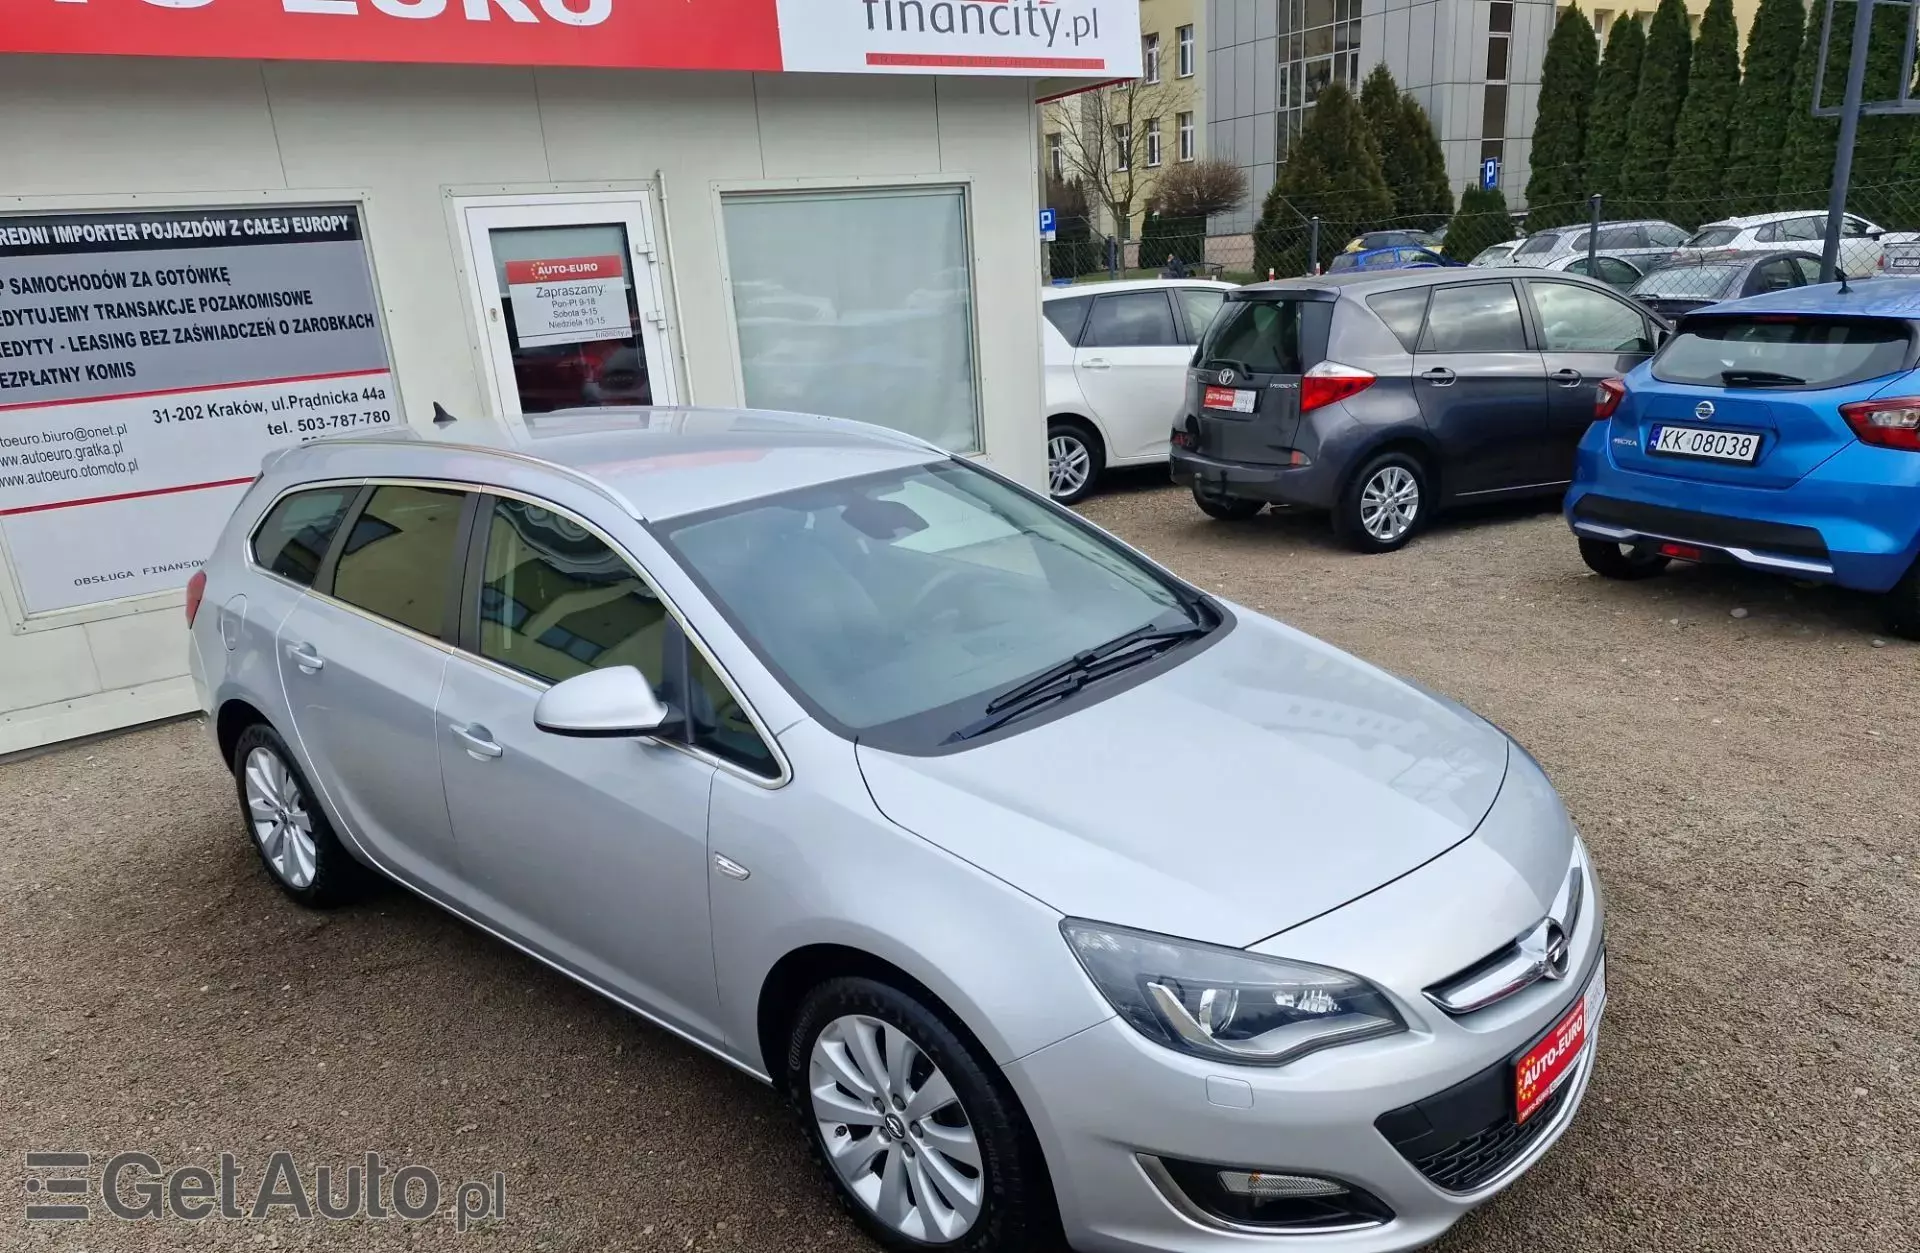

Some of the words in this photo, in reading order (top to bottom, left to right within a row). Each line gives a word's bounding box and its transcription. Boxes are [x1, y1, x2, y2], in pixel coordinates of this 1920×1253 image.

[1487, 161, 1495, 183] P
[52, 223, 139, 243] IMPORTER
[141, 216, 227, 240] POJAZDÓW
[230, 219, 241, 236] Z
[243, 216, 289, 235] CAŁEJ
[292, 214, 348, 233] EUROPY
[1041, 211, 1051, 229] P
[9, 268, 127, 295] SAMOCHODÓW
[130, 271, 152, 289] ZA
[155, 264, 231, 287] GOTÓWKĘ
[537, 262, 598, 275] AUTO-EURO
[535, 284, 607, 299] Zapraszamy:
[94, 298, 197, 320] TRANSAKCJE
[200, 290, 313, 314] POZAKOMISOWE
[551, 299, 577, 308] Pon-Pt
[579, 298, 596, 306] 9-18
[553, 309, 579, 318] Sobota
[581, 308, 598, 316] 9-15
[68, 331, 137, 352] LEASING
[141, 327, 171, 347] BEZ
[174, 317, 276, 344] ZAŚWIADCZEŃ
[279, 318, 289, 335] O
[293, 313, 375, 334] ZAROBKACH
[548, 319, 582, 329] Niedziela
[585, 317, 606, 326] 10-15
[85, 361, 136, 381] KOMIS
[153, 405, 204, 424] 31-202
[208, 398, 268, 418] Kraków,
[271, 390, 358, 413] ul.Prądnicka
[362, 386, 386, 403] 44a
[267, 421, 292, 435] tel.
[298, 410, 391, 432] 503-787-780
[1661, 429, 1687, 450] KK
[1691, 433, 1752, 457] 08038
[74, 570, 135, 587] OBSŁUGA
[1523, 1014, 1583, 1089] AUTO-EURO
